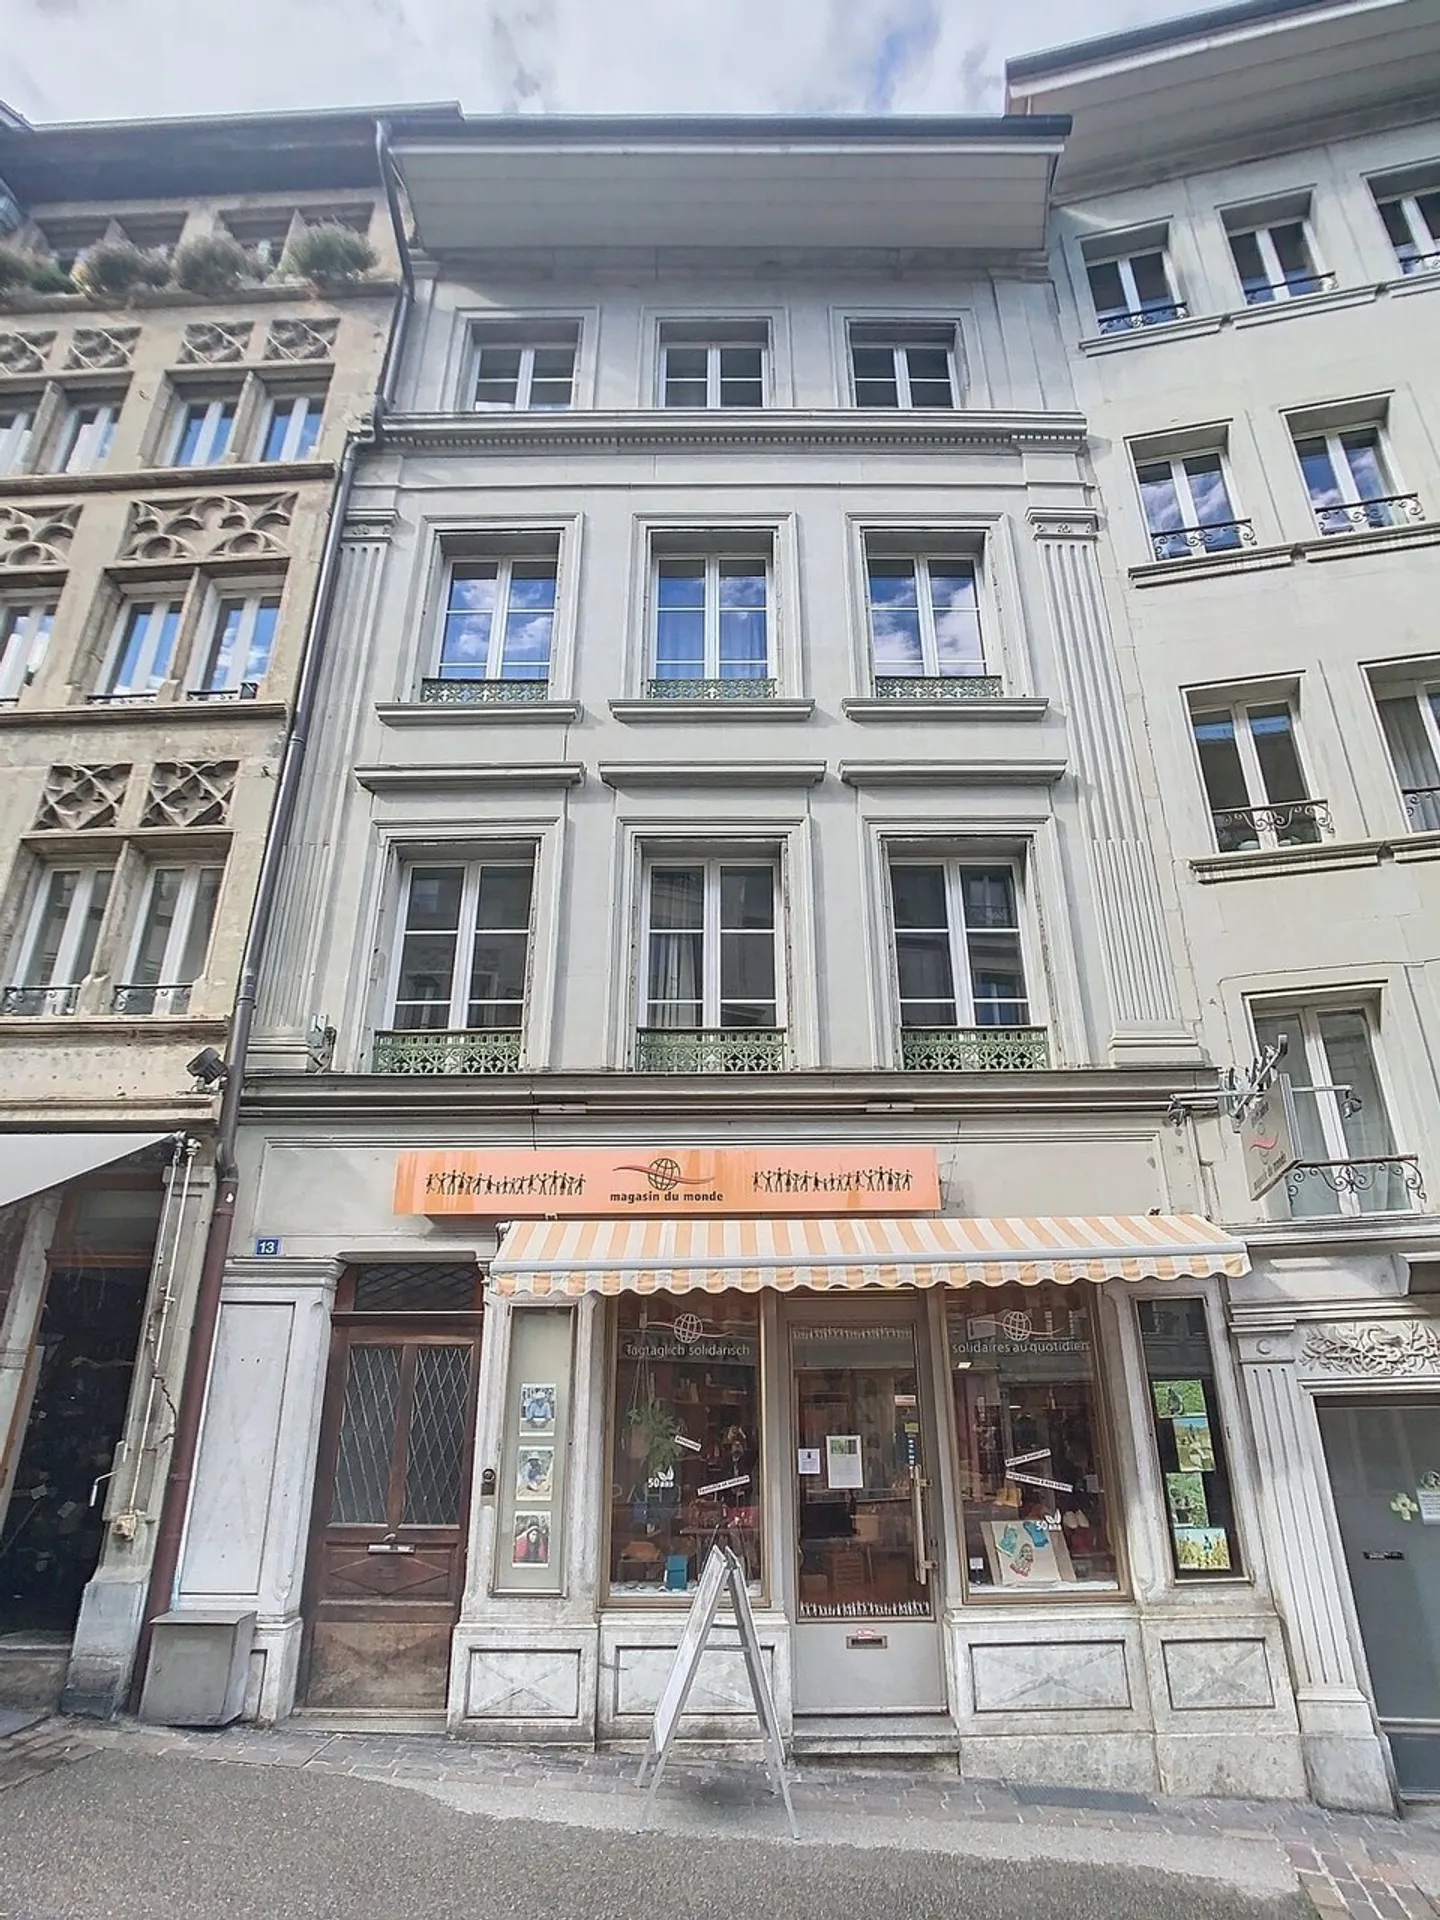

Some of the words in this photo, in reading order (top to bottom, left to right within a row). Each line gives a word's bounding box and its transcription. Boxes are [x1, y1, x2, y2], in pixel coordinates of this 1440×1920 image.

[610, 1191, 660, 1204] magasin
[664, 1191, 679, 1201] du
[683, 1191, 724, 1202] monde
[259, 1241, 275, 1254] 13
[688, 1344, 750, 1356] solidarisch
[952, 1341, 1011, 1353] solidaires
[1012, 1343, 1028, 1353] au
[1029, 1340, 1090, 1354] quotidien
[647, 1477, 660, 1488] 50
[1036, 1520, 1048, 1531] 50
